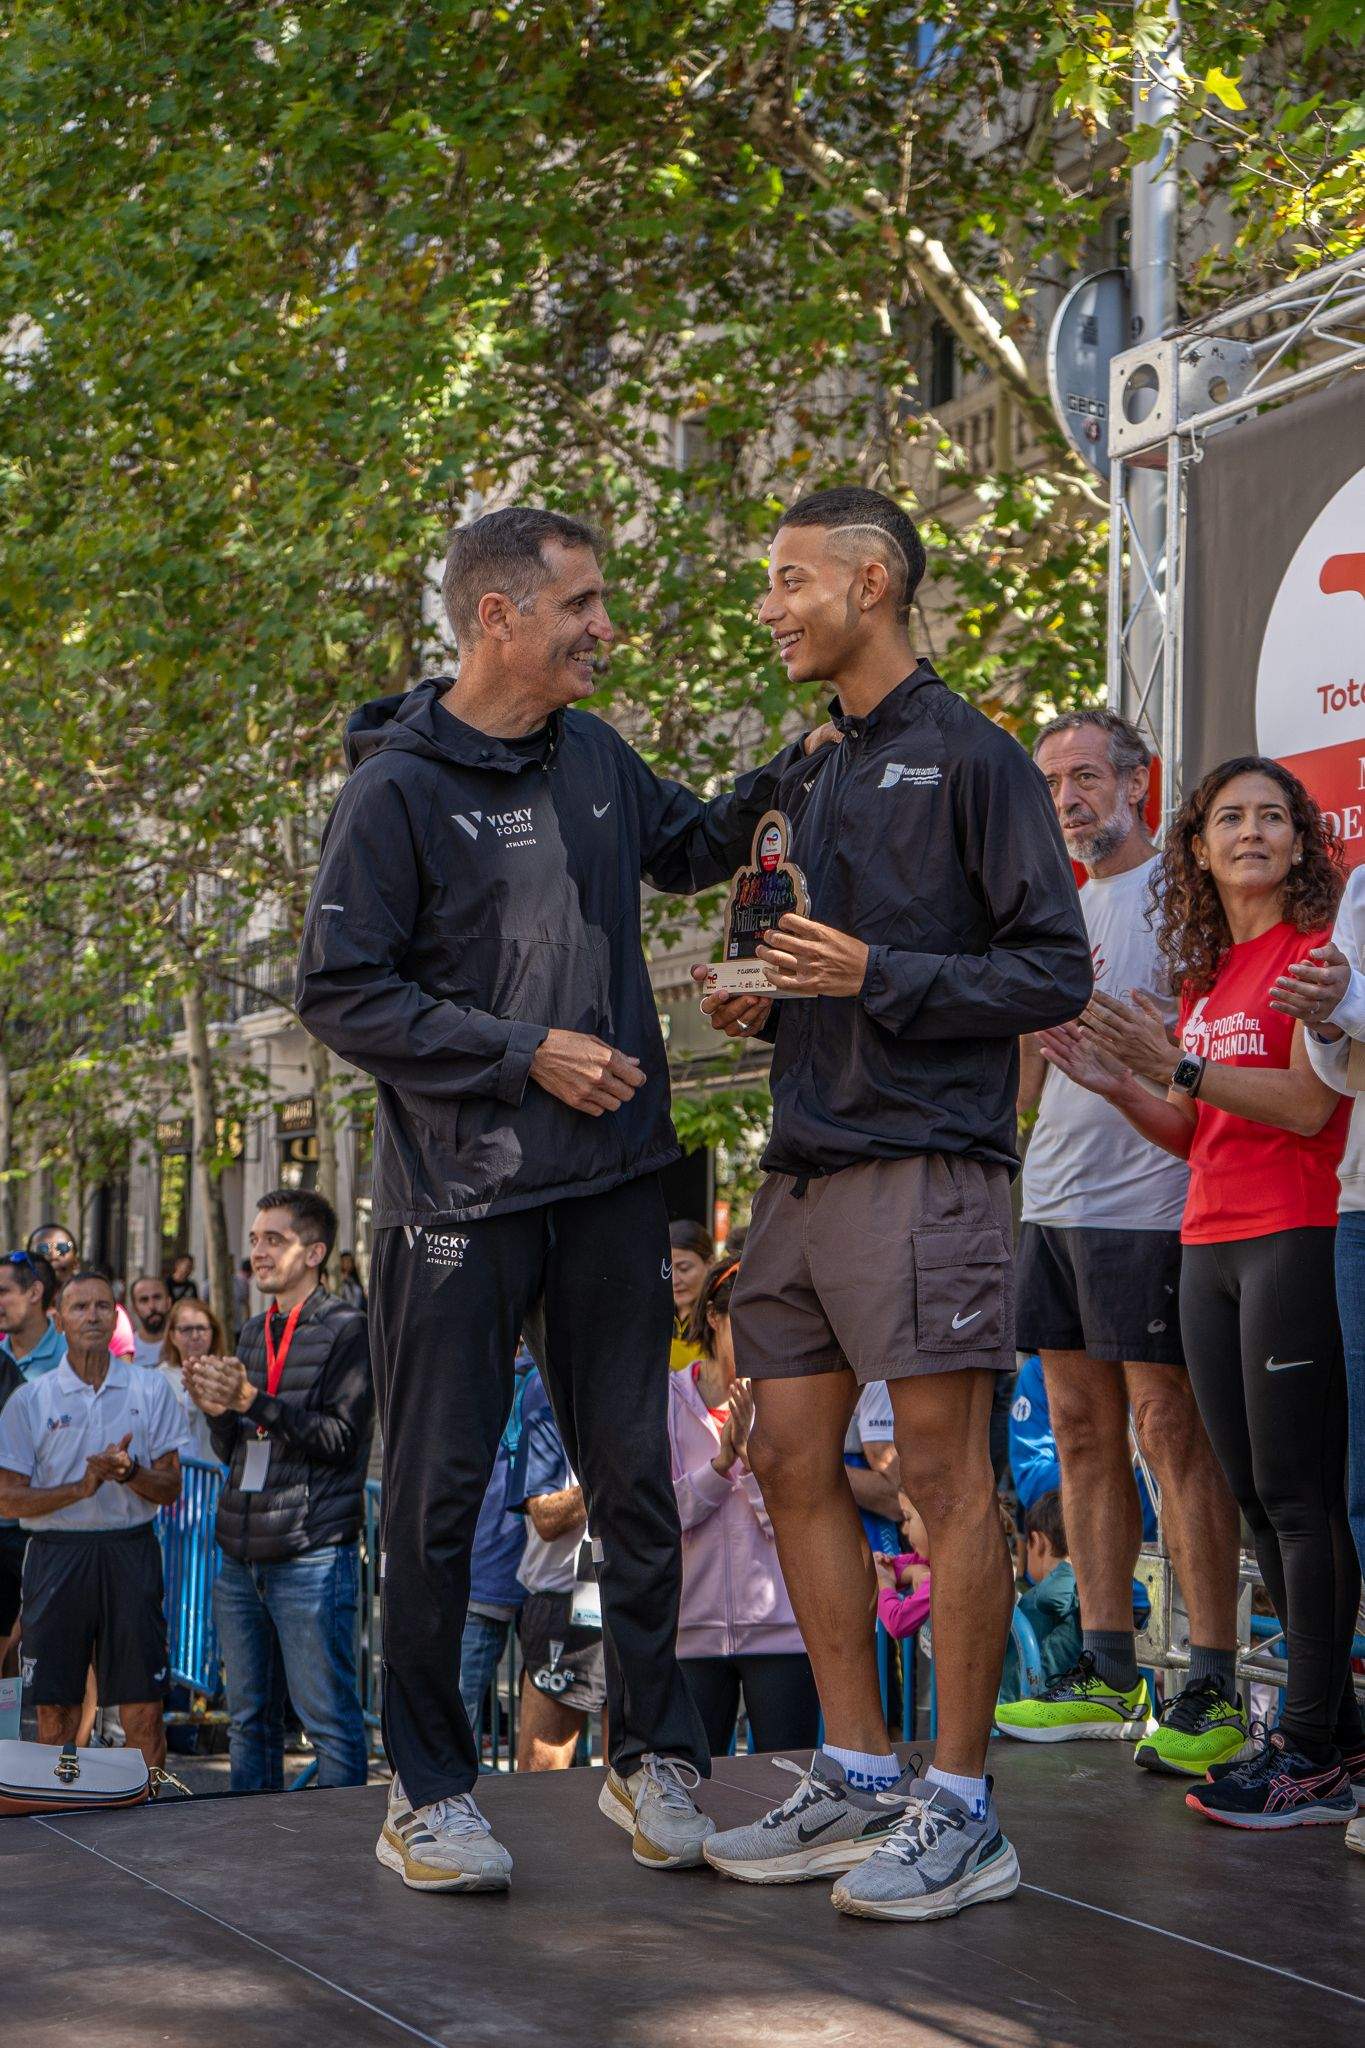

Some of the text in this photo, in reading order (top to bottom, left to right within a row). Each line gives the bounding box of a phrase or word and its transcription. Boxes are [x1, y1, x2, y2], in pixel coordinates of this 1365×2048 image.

[1317, 679, 1365, 714] Tot
[486, 808, 532, 827] VICKY
[496, 823, 533, 836] FOODS
[505, 839, 536, 848] ATHLETICS
[1212, 1011, 1245, 1038] PODER
[1244, 1018, 1261, 1031] DEL
[1211, 1033, 1268, 1061] CHANDAL
[424, 1233, 470, 1249] VICKY
[427, 1246, 464, 1259] FOODS
[426, 1258, 463, 1267] ATHLETICS
